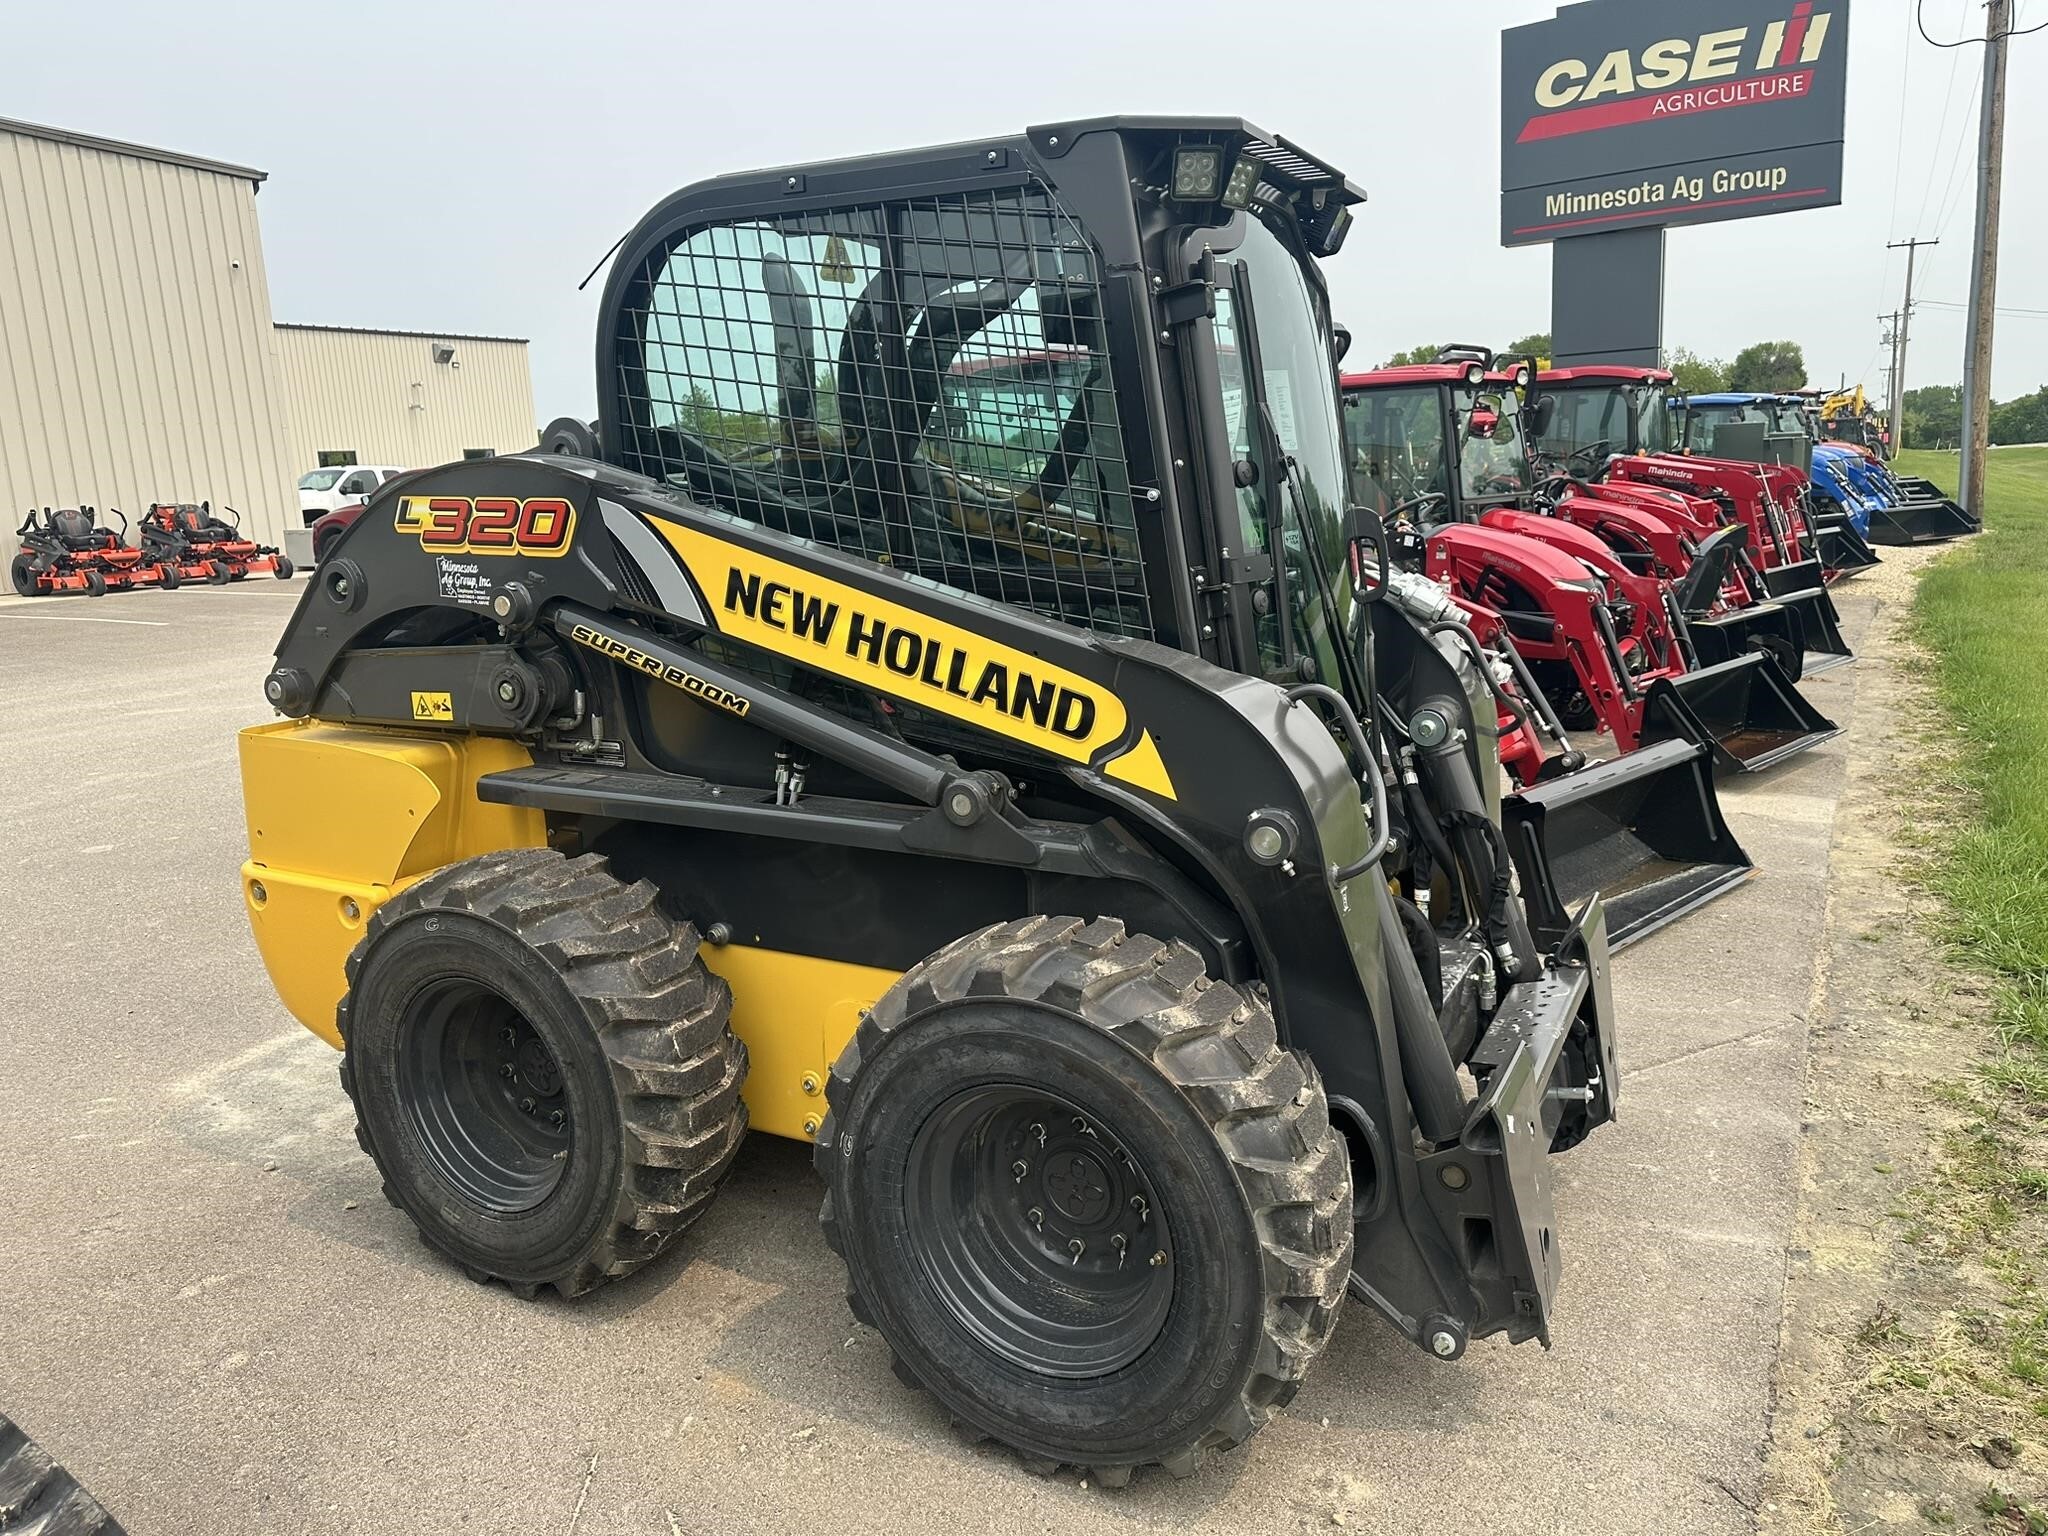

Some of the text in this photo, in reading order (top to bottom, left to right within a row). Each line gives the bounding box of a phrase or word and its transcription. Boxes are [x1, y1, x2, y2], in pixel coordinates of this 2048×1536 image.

[1534, 27, 1748, 108] CASE
[1652, 75, 1804, 115] AGRICULTURE
[1546, 166, 1787, 217] Minnesota Ag Group
[1648, 465, 1693, 479] Mahindra
[396, 498, 571, 548] L320
[440, 560, 478, 573] Minnesota
[572, 625, 750, 717] SUPER BOOM
[724, 566, 1096, 741] NEW HOLLAND
